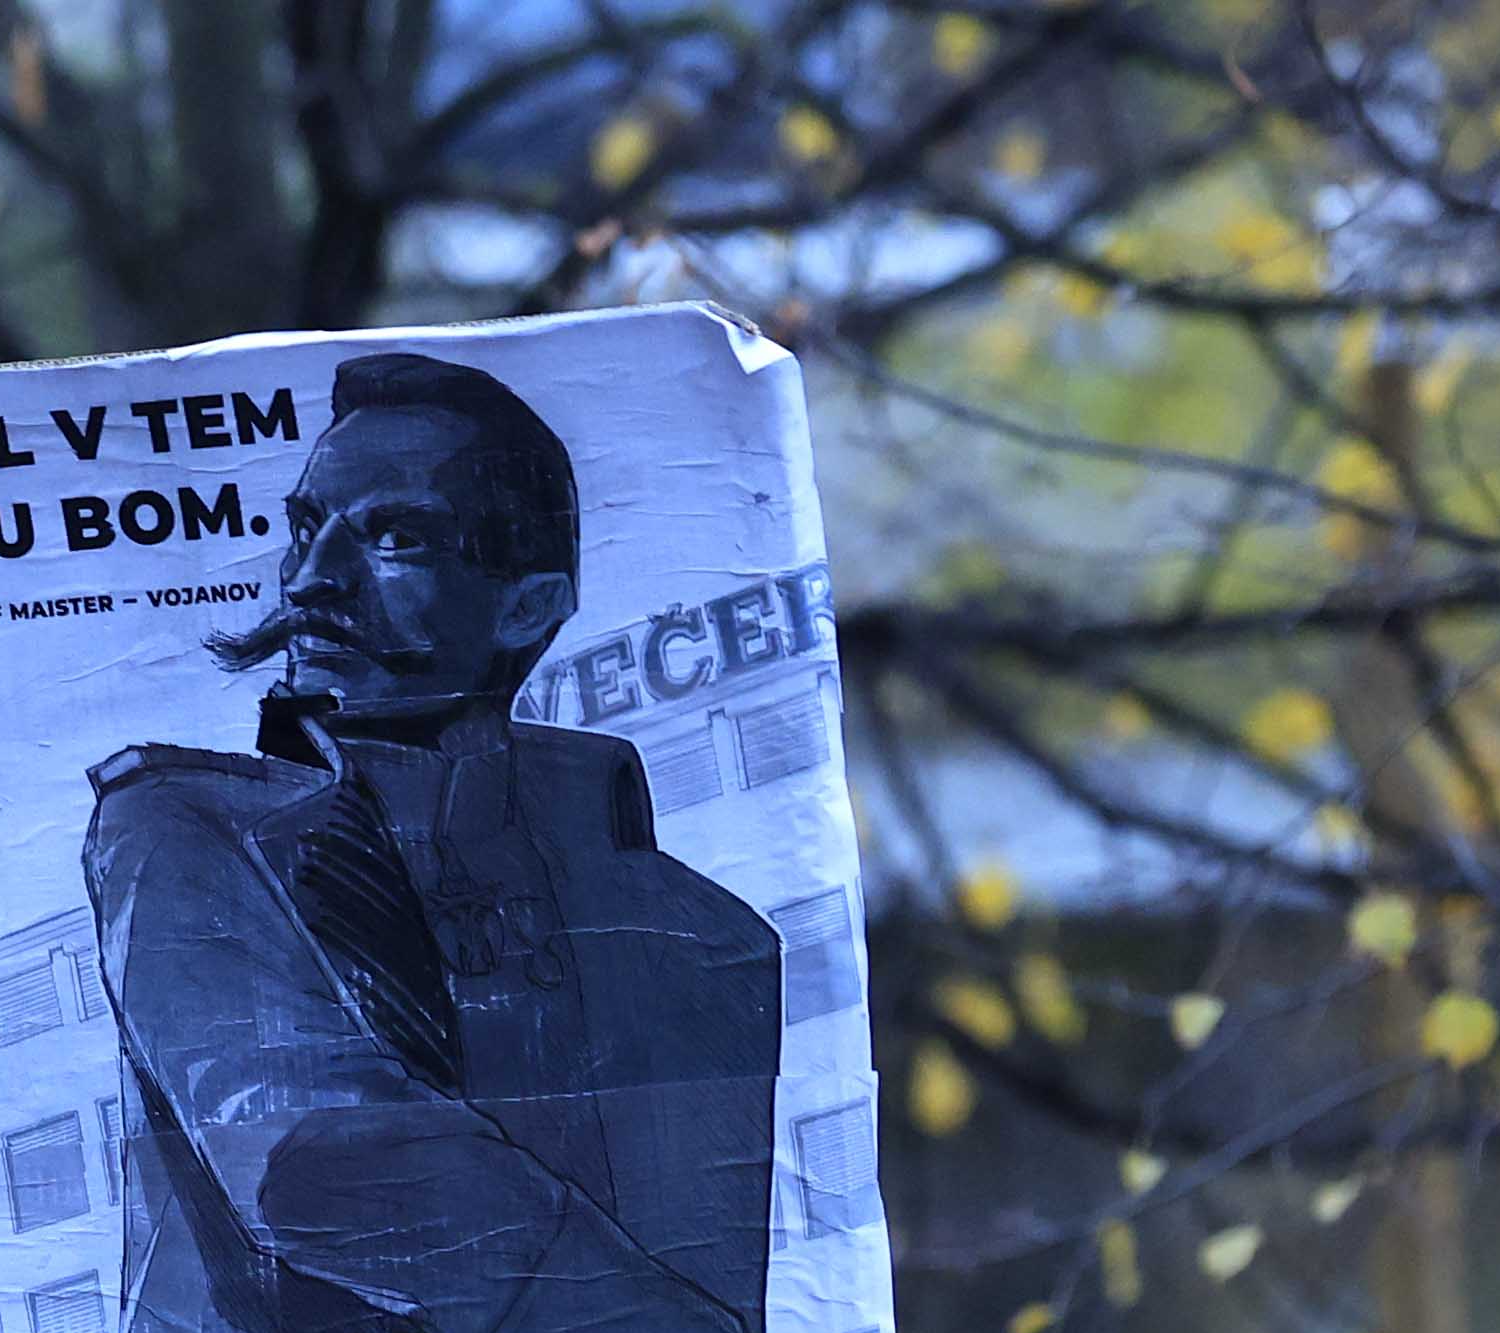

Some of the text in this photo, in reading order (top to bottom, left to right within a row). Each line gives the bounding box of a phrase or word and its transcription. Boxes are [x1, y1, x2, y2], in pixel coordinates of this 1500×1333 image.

[49, 406, 108, 460] V
[130, 388, 300, 453] TEM
[60, 482, 271, 552] BOM.
[9, 594, 115, 621] MAISTER
[145, 581, 262, 608] VOJANOV
